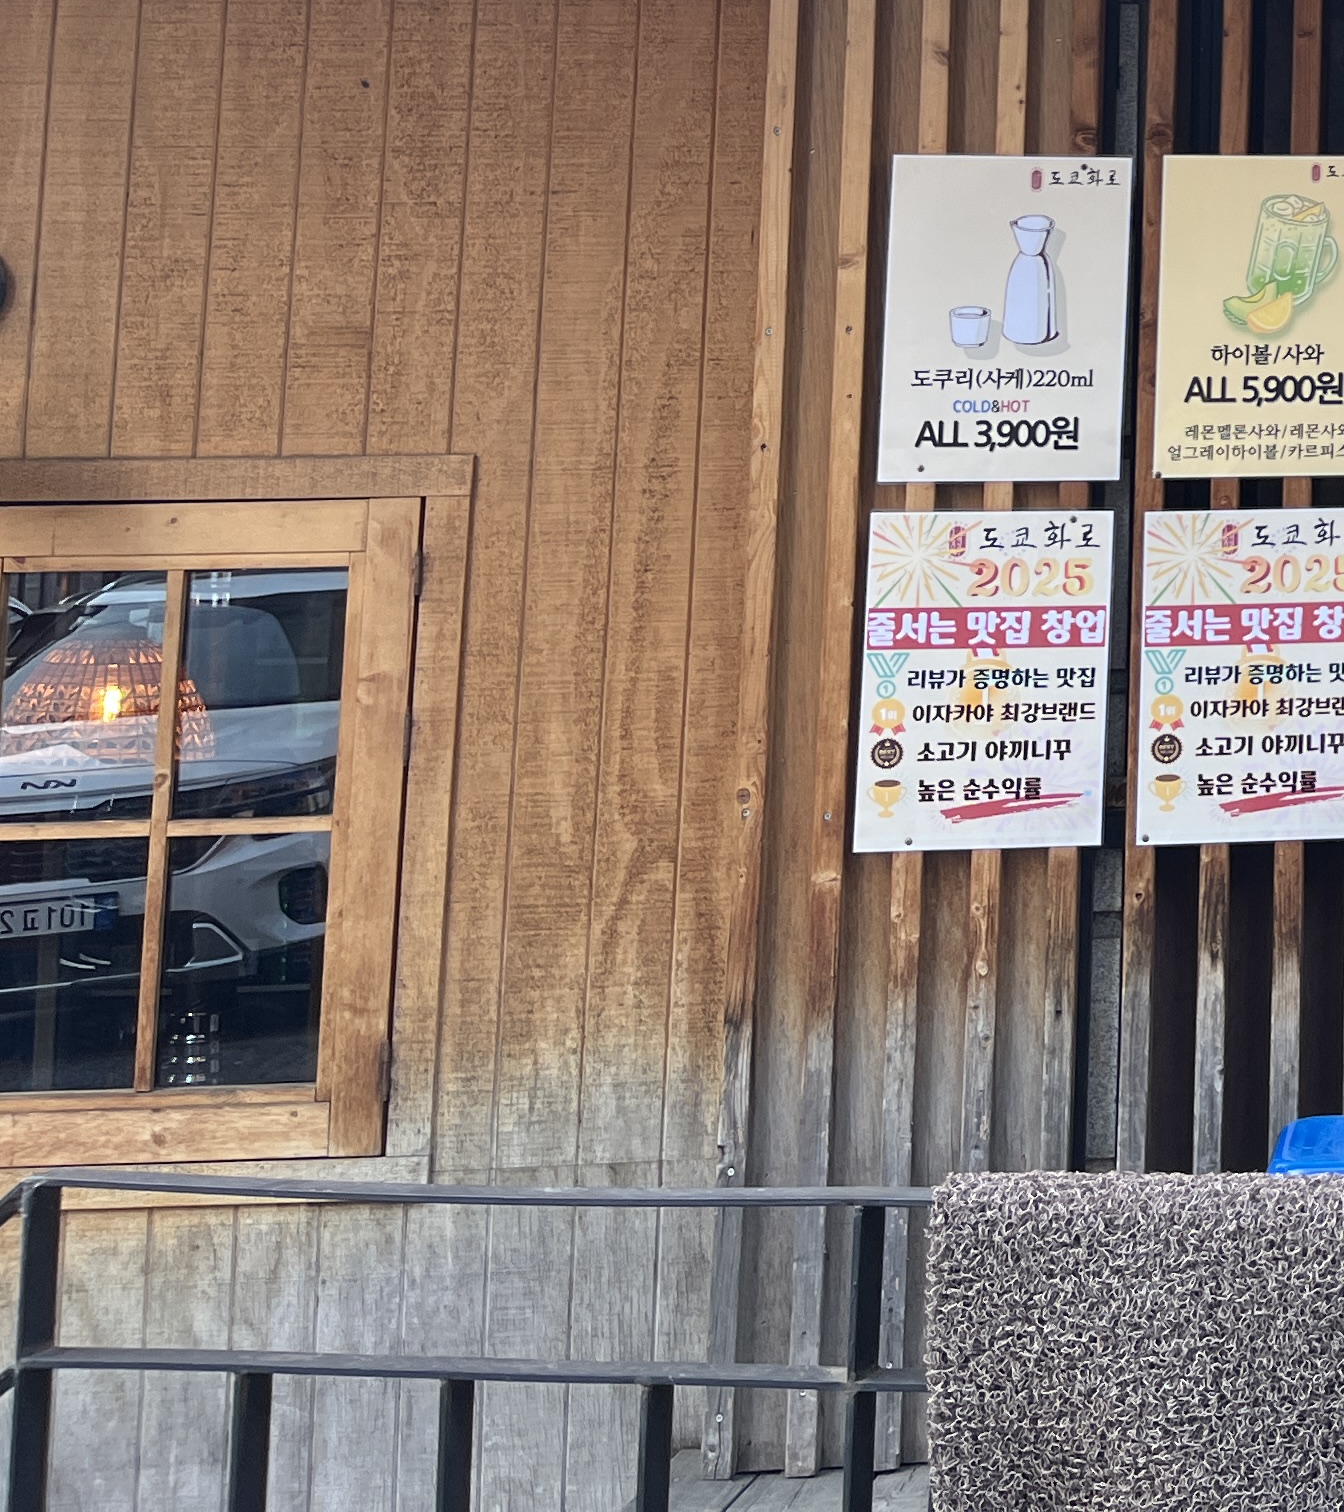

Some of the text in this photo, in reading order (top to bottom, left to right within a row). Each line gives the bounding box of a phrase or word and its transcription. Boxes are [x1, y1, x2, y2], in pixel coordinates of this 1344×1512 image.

[1211, 344, 1324, 365] 하이볼/사와
[911, 368, 1094, 390] 도쿠리(사케)220ml
[1184, 372, 1344, 407] ALL 5,900원
[953, 400, 1030, 413] COLD&HOT
[915, 417, 1079, 452] ALL 3,900원
[979, 521, 1101, 550] 도쿄화로
[967, 558, 1094, 597] 2025
[867, 609, 1106, 647] 줄서는 맛집 창업
[1146, 609, 1232, 644] 줄서는
[1241, 606, 1304, 642] 맛집
[907, 666, 1096, 689] 리뷰가 증명하는 맛집
[1185, 666, 1241, 685] 리뷰가
[1248, 664, 1322, 685] 증명하는
[912, 700, 1096, 723] 이자카야 최강브랜드
[1190, 699, 1269, 719] 이자카야
[917, 739, 1071, 762] 소고기 야끼니꾸
[1195, 736, 1253, 756] 소고기
[1262, 733, 1344, 755] 야끼니꾸
[918, 777, 1041, 802] 높은 순수익률
[1197, 770, 1317, 796] 높은 순수익률
